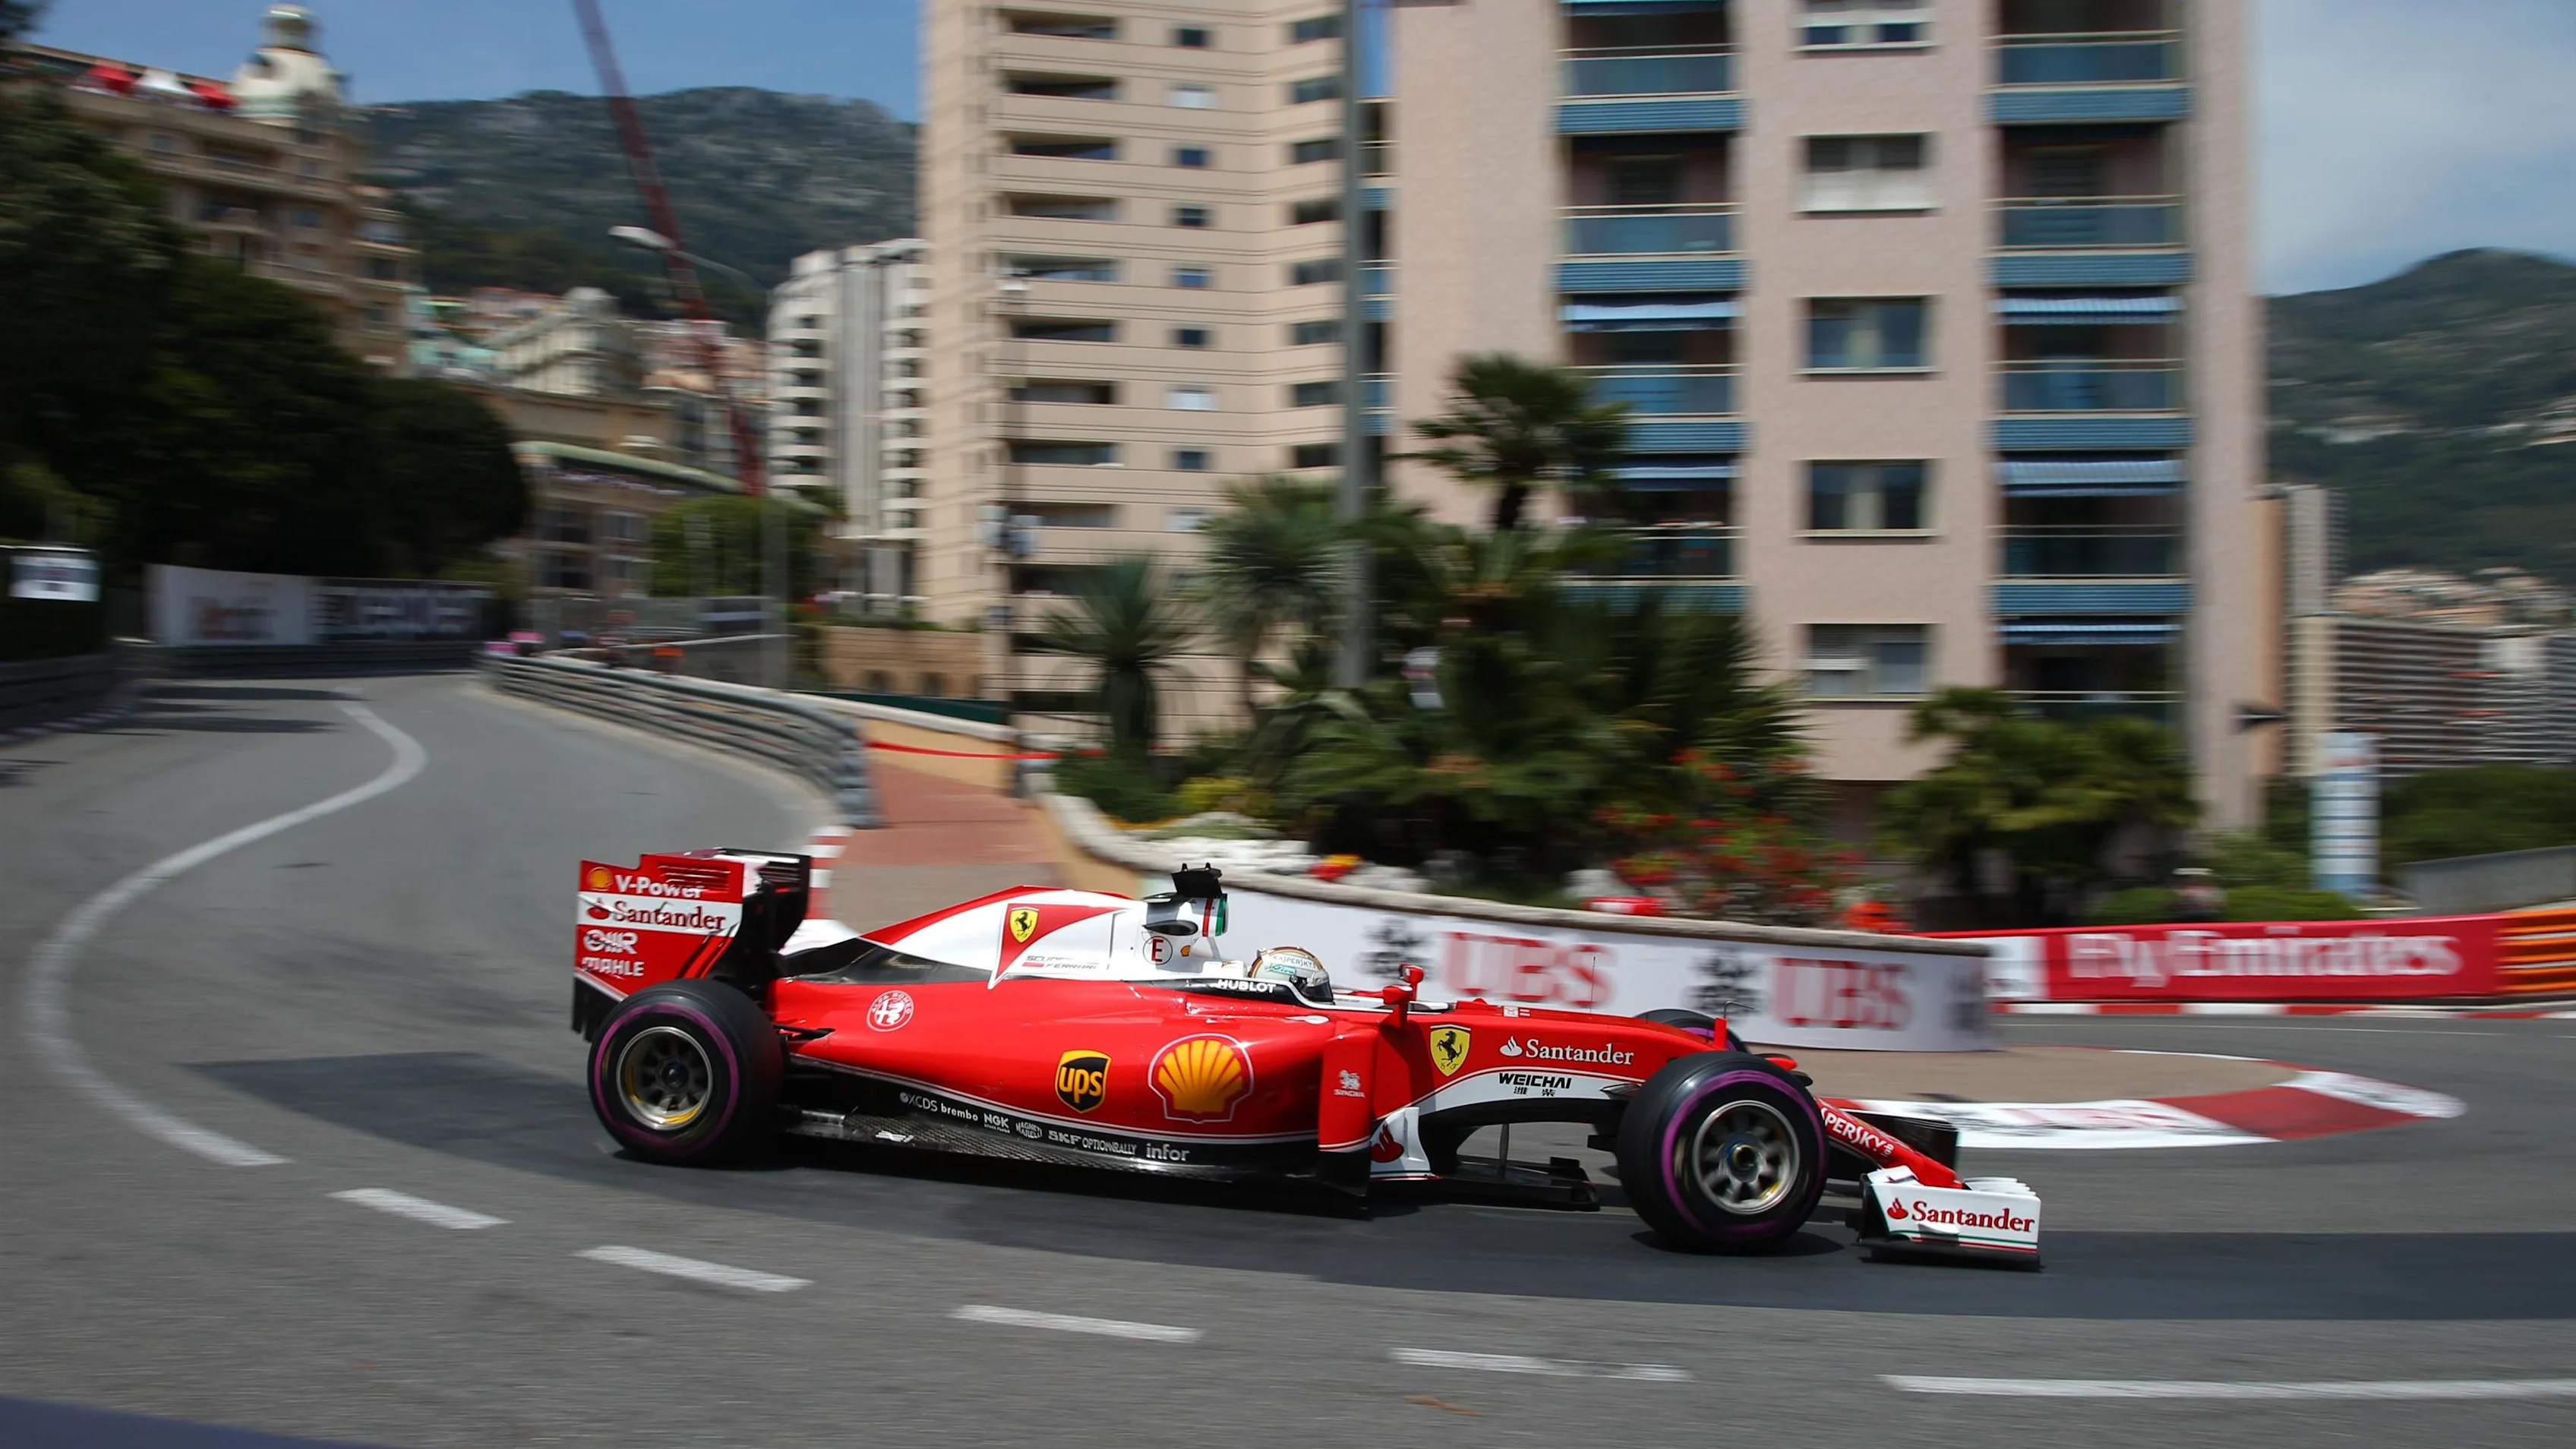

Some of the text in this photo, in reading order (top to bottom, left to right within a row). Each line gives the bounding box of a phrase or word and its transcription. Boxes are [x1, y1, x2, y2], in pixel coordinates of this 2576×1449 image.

[614, 874, 702, 898] V-Power
[613, 901, 727, 930] Santander
[1151, 939, 1164, 962] E
[2166, 924, 2464, 978] Emirates
[581, 957, 645, 977] MAHLE
[1443, 930, 1617, 1008] UBS
[1217, 978, 1276, 993] HUBLOT
[1525, 1038, 1634, 1065] Santander
[1059, 1066, 1103, 1103] ups
[1498, 1072, 1572, 1089] WEICHAI
[941, 1103, 979, 1122] brembo
[983, 1113, 1009, 1129] NGK
[1048, 1129, 1081, 1145] SKF
[1145, 1143, 1190, 1162] infor
[1911, 1201, 2035, 1233] Santander
